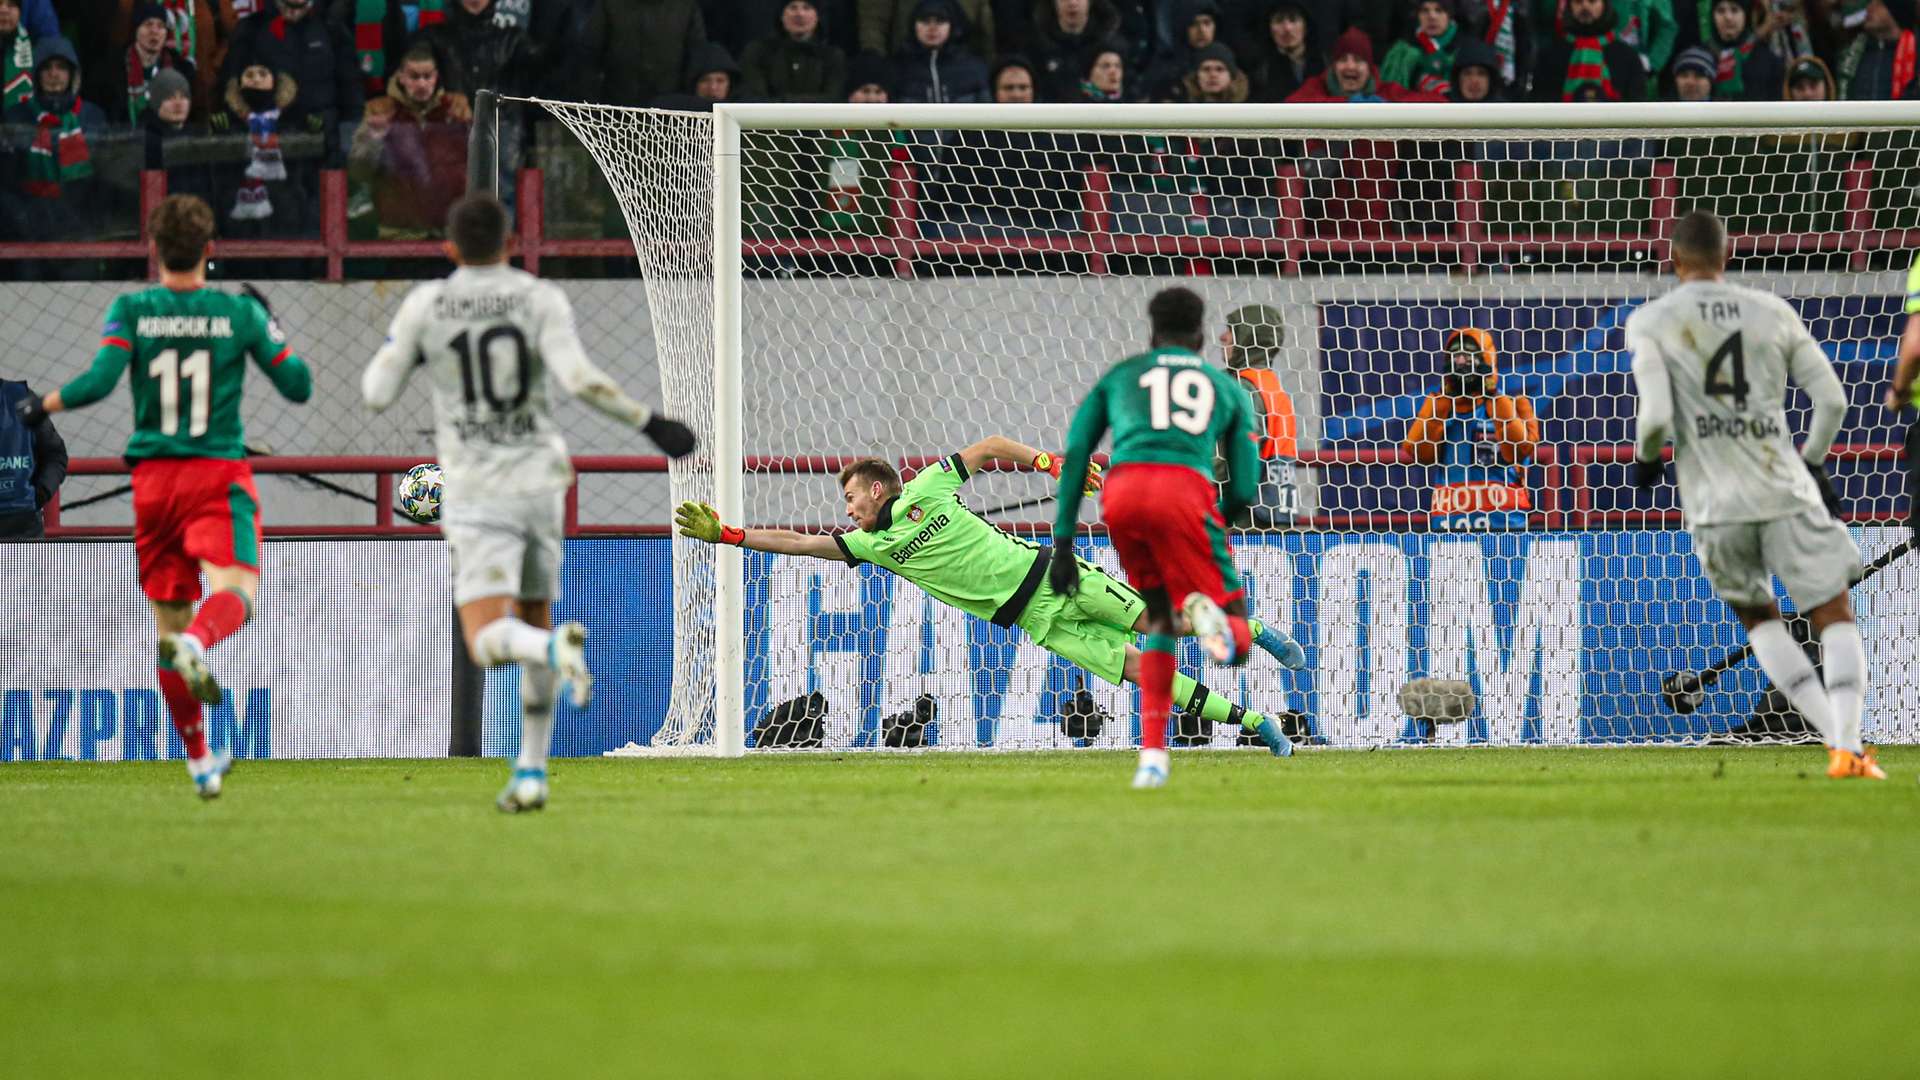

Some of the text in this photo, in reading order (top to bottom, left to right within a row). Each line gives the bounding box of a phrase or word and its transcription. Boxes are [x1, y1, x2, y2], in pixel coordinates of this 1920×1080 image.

[1697, 302, 1741, 321] TAH
[148, 348, 211, 438] 11
[448, 326, 529, 414] 10
[1139, 366, 1216, 435] 19
[1705, 330, 1749, 414] 4
[890, 513, 951, 566] Barmenia
[1105, 585, 1127, 603] 1
